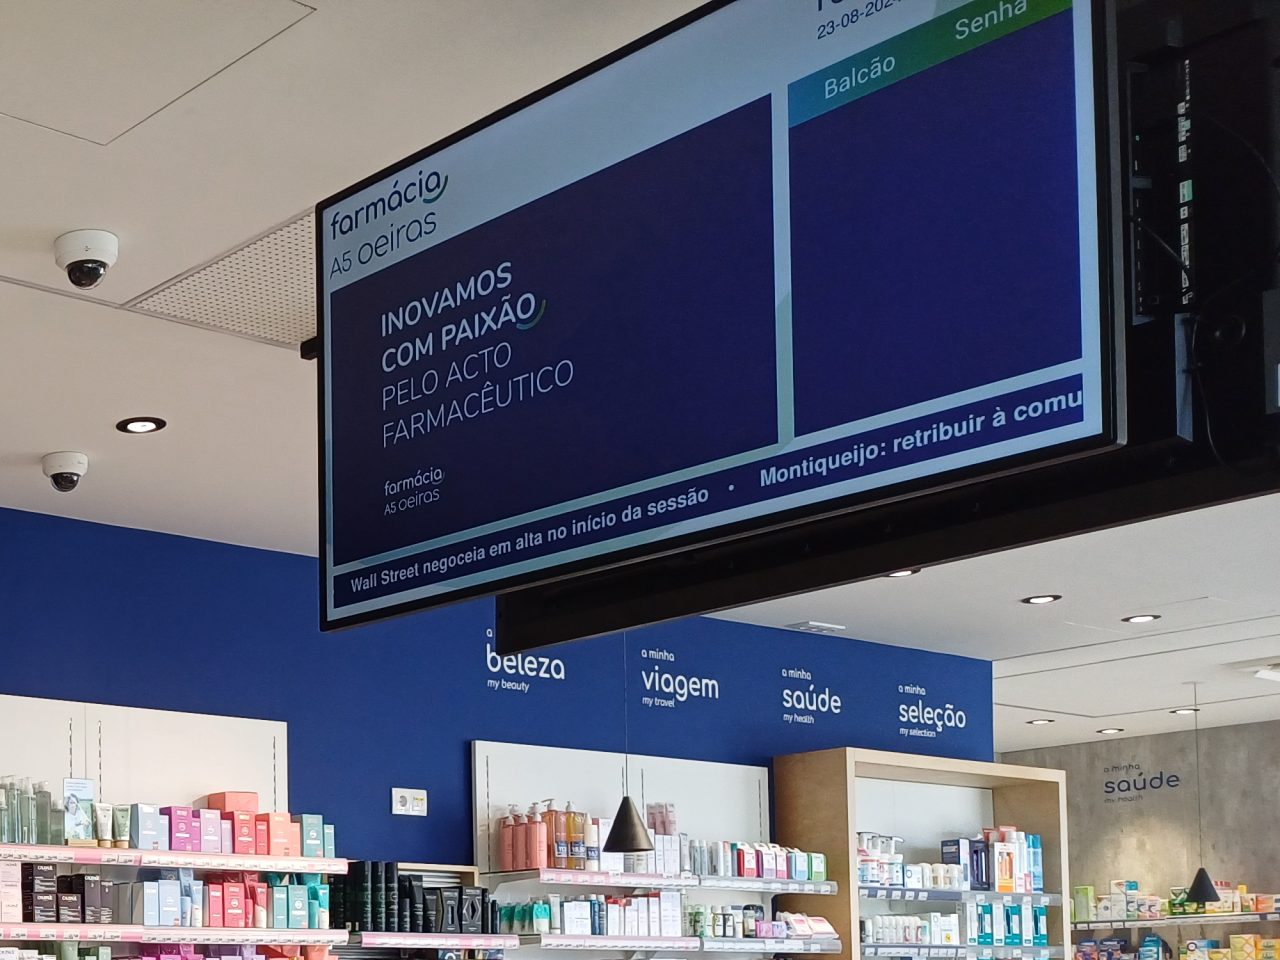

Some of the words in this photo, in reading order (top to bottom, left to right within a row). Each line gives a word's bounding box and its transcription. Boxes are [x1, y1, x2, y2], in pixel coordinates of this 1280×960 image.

[955, 0, 1028, 40] Senha
[825, 56, 896, 99] Balcão
[331, 170, 442, 240] farmácia
[329, 251, 352, 280] A5
[357, 212, 437, 265] oeiras
[381, 262, 512, 337] INOVAMOS
[381, 333, 433, 373] COM
[441, 292, 536, 350] PAIXÃO
[382, 370, 438, 411] PELO
[445, 342, 512, 388] ACTO
[382, 360, 574, 448] FARMACÊUTICO
[351, 572, 377, 593] Wall
[381, 563, 419, 585] Street
[423, 546, 486, 575] negoceia
[489, 540, 512, 557] em
[516, 531, 543, 551] alta
[548, 526, 567, 543] no
[571, 512, 617, 536] início
[621, 505, 642, 523] da
[647, 487, 709, 517] sessão
[760, 442, 887, 487] Montiqueijo:
[893, 414, 985, 453] retribuir
[992, 406, 1006, 427] à
[1013, 389, 1083, 422] comu
[384, 467, 443, 496] farmácia
[384, 501, 397, 516] A5
[398, 488, 440, 511] oeiras
[486, 628, 493, 637] a
[486, 643, 565, 680] beleza
[641, 649, 648, 658] a
[648, 648, 675, 662] minha
[487, 679, 500, 691] my
[501, 678, 530, 693] beauty
[641, 665, 719, 702] viagem
[788, 668, 812, 680] minha
[642, 696, 653, 707] my
[654, 696, 675, 708] travel
[782, 684, 841, 713] saúde
[904, 684, 926, 696] minha
[783, 713, 793, 724] my
[794, 713, 815, 724] health
[899, 699, 966, 731] seleção
[900, 727, 909, 737] my
[909, 726, 936, 738] selection
[1104, 771, 1180, 793] saúde
[1111, 763, 1140, 774] minha
